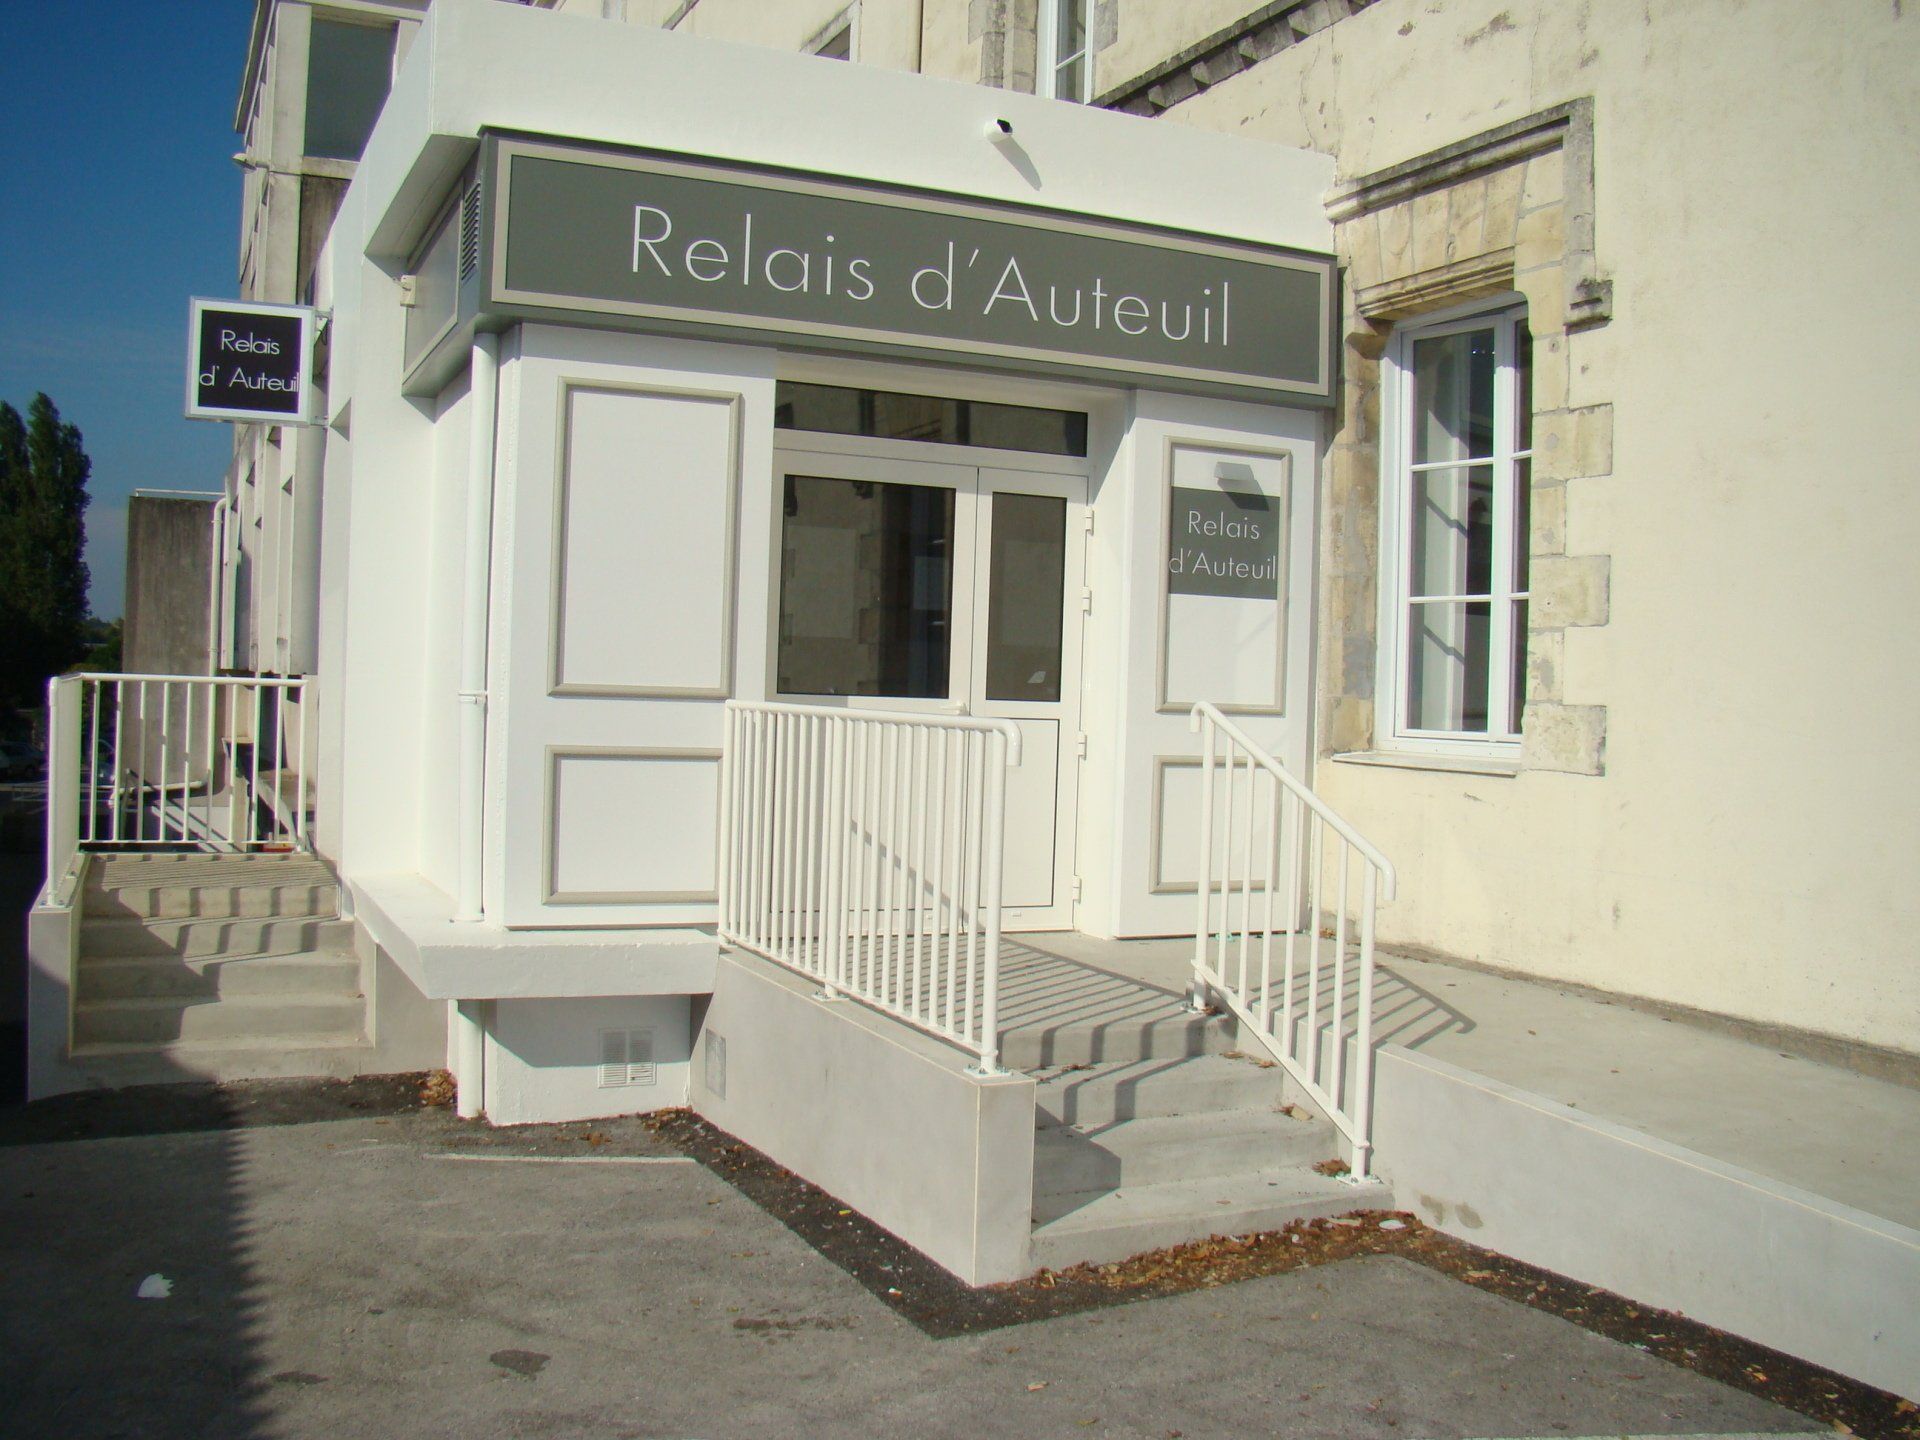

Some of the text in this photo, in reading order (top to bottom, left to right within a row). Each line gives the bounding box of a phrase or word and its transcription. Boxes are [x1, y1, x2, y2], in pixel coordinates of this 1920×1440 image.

[632, 205, 1230, 347] Relais d'Auteuil
[221, 329, 280, 355] Relais
[228, 367, 300, 392] Auteuil
[1188, 510, 1260, 540] Relais
[1168, 547, 1276, 580] d'Auteuil
